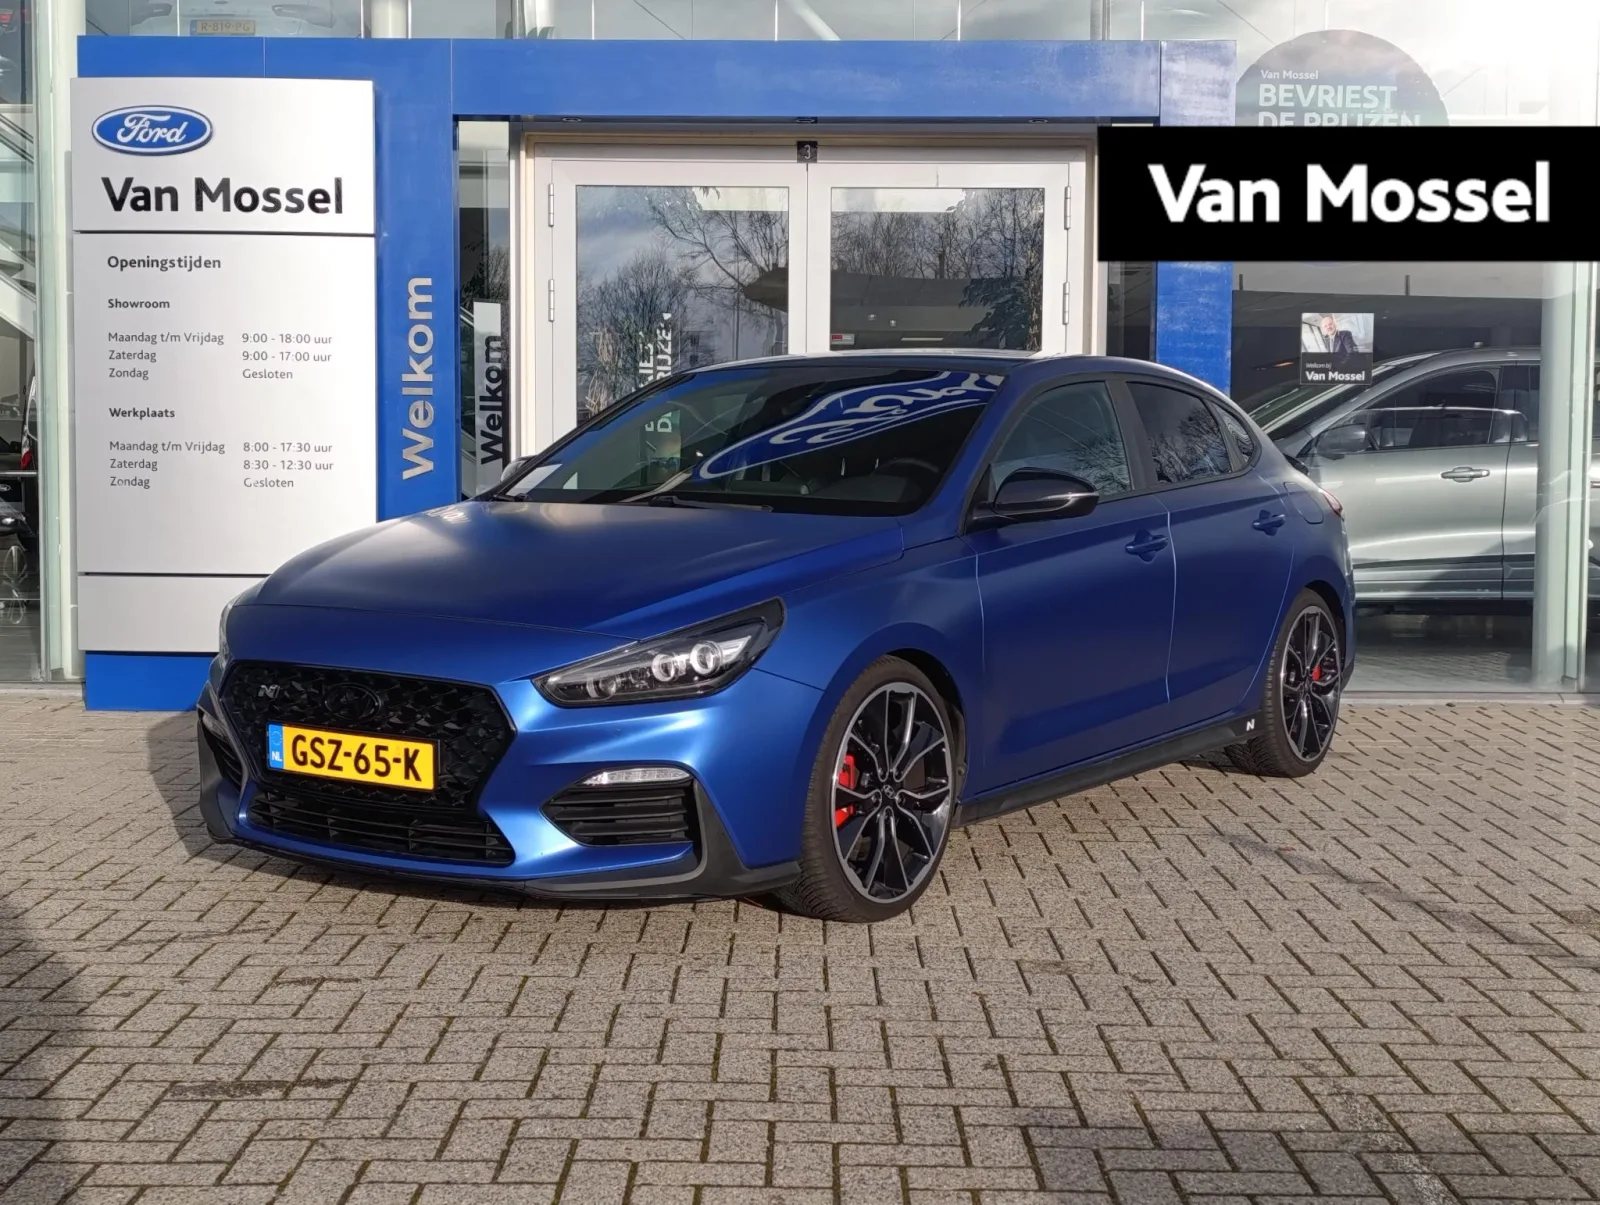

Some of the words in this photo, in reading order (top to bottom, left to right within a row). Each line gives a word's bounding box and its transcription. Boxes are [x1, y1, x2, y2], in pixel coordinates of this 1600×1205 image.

[1260, 69, 1280, 79] Van
[1282, 69, 1319, 80] Mossel
[1258, 83, 1398, 109] BEVRIEST
[116, 112, 187, 143] Ford
[804, 144, 811, 160] 3
[100, 176, 179, 212] Van
[193, 176, 343, 214] Mossel
[107, 255, 222, 272] Openingstijden
[107, 298, 170, 309] Showroom
[108, 331, 158, 345] Maandag
[160, 331, 181, 344] t/m
[183, 332, 225, 346] Vrijdag
[241, 333, 268, 344] 9:00
[279, 333, 311, 345] 18:00
[313, 335, 333, 345] uur
[108, 350, 157, 363] Zaterdag
[242, 351, 268, 362] 9:00
[280, 351, 311, 362] 17:00
[313, 353, 332, 362] uur
[108, 367, 150, 381] Zondag
[242, 368, 294, 380] Gesloten
[401, 276, 434, 481] Welkom
[1305, 371, 1326, 380] Van
[1328, 371, 1365, 380] Mossel
[479, 334, 503, 466] Welkom
[108, 407, 176, 421] Werkplaats
[109, 441, 159, 455] Maandag
[161, 442, 182, 453] t/m
[185, 441, 226, 455] Vrijdag
[243, 442, 269, 453] 8:00
[280, 442, 311, 453] 17:30
[314, 444, 333, 453] uur
[109, 458, 158, 472] Zaterdag
[243, 460, 269, 471] 8:30
[280, 460, 312, 471] 12:30
[314, 462, 334, 471] uur
[109, 476, 151, 490] Zondag
[243, 477, 294, 488] Gesloten
[1245, 718, 1256, 731] N
[270, 750, 283, 763] NL
[291, 733, 423, 782] GSZ-65-K
